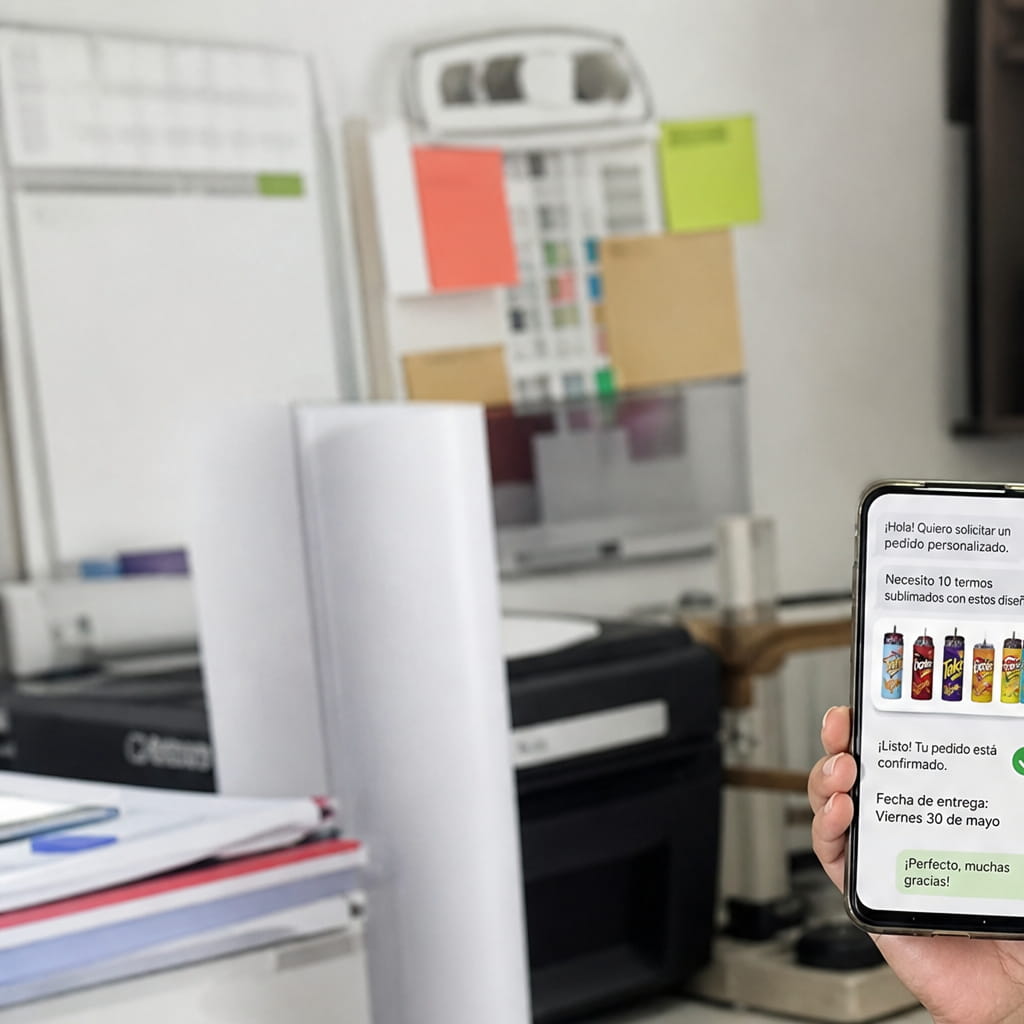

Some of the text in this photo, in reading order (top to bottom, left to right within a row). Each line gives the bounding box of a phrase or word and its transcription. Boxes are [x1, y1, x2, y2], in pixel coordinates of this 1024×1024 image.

[884, 521, 1011, 537] ¡Hola! Quiero solicitar un
[884, 538, 1009, 554] pedido personalizado.
[885, 574, 993, 589] Necesito 10 termos
[884, 591, 944, 604] sublimados
[946, 594, 966, 604] con
[968, 595, 996, 605] estos
[878, 740, 997, 756] ¡Listo! Tu pedido está
[878, 757, 948, 771] confirmado.
[876, 793, 989, 811] Fecha de entrega:
[875, 810, 1000, 830] Viernes 30 de mayo
[904, 857, 1010, 873] ¡Perfecto, muchas
[904, 875, 950, 888] gracias!
